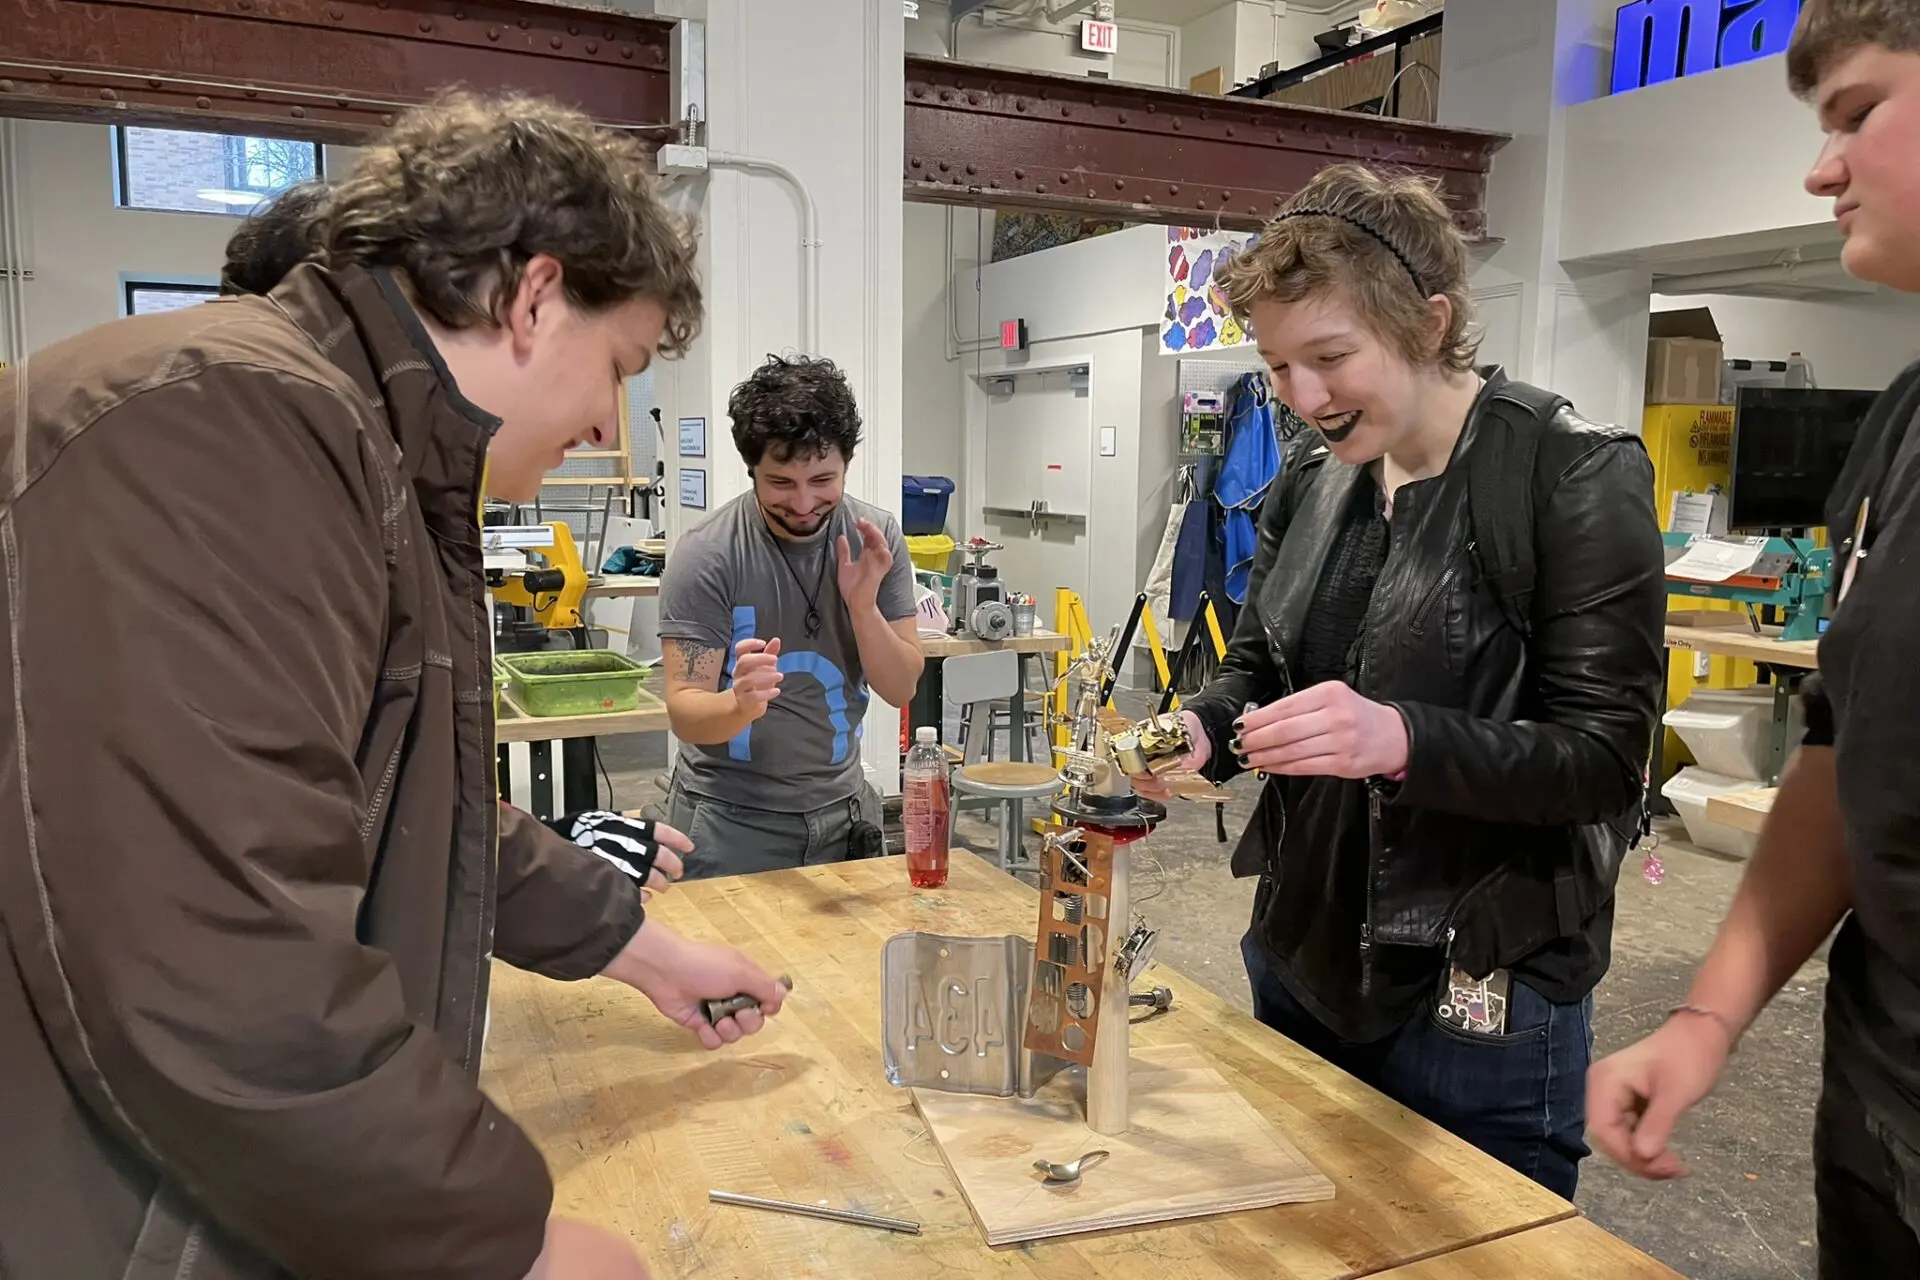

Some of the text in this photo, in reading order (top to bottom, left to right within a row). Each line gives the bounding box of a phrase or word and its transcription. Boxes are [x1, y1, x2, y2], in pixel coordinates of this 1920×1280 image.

[1088, 22, 1113, 48] EXIT
[1700, 410, 1731, 425] FLAMMABLE
[1678, 640, 1691, 649] Only
